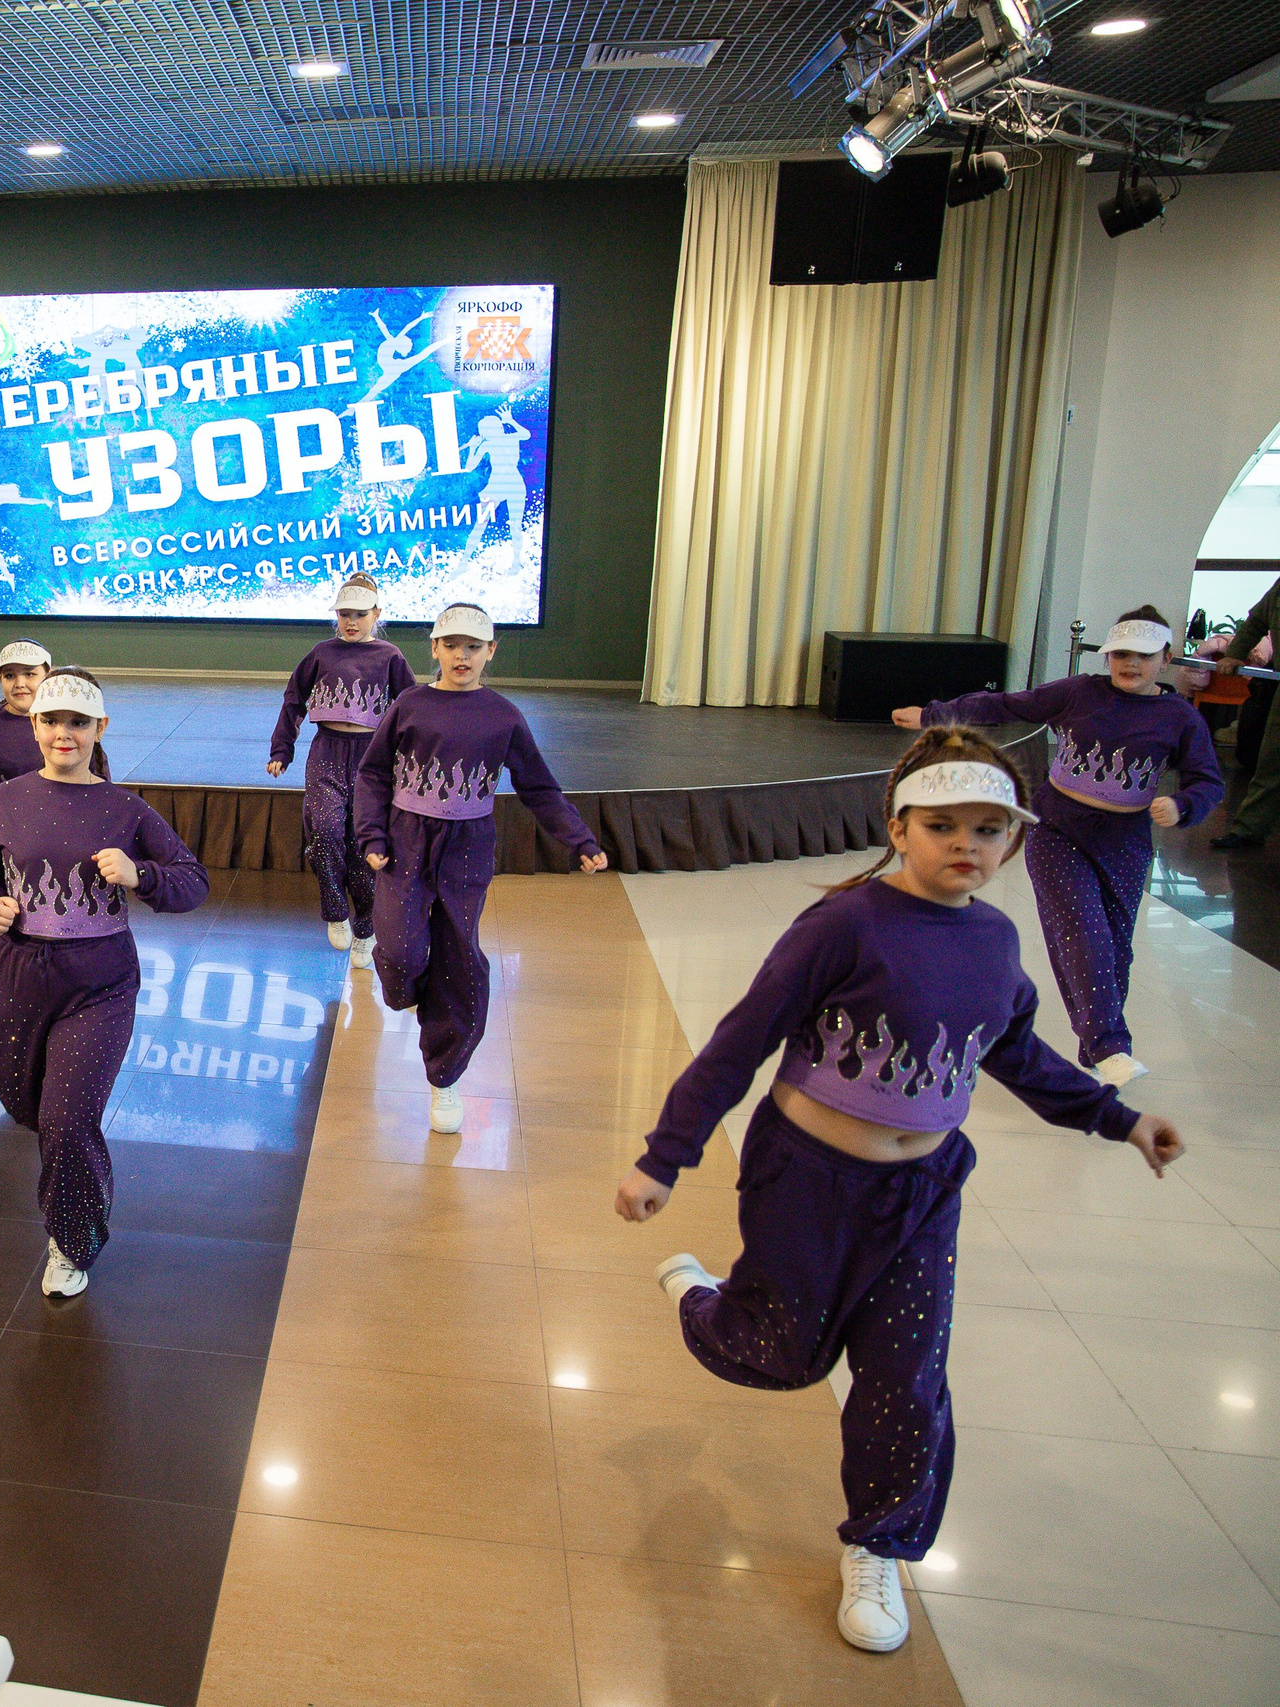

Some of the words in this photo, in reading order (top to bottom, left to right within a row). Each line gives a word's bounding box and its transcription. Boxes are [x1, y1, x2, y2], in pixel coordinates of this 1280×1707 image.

[457, 301, 523, 314] ЯРКОФФ
[463, 362, 535, 373] КОРПОРАЦИЯ
[41, 390, 469, 521] УЗОРЫ
[52, 513, 342, 567] ВСЕРОССИЙСКИЙ
[357, 497, 497, 536] ЗИМНИЙ
[93, 543, 451, 597] КОНКУРС-ФЕСТИВАЛЬ
